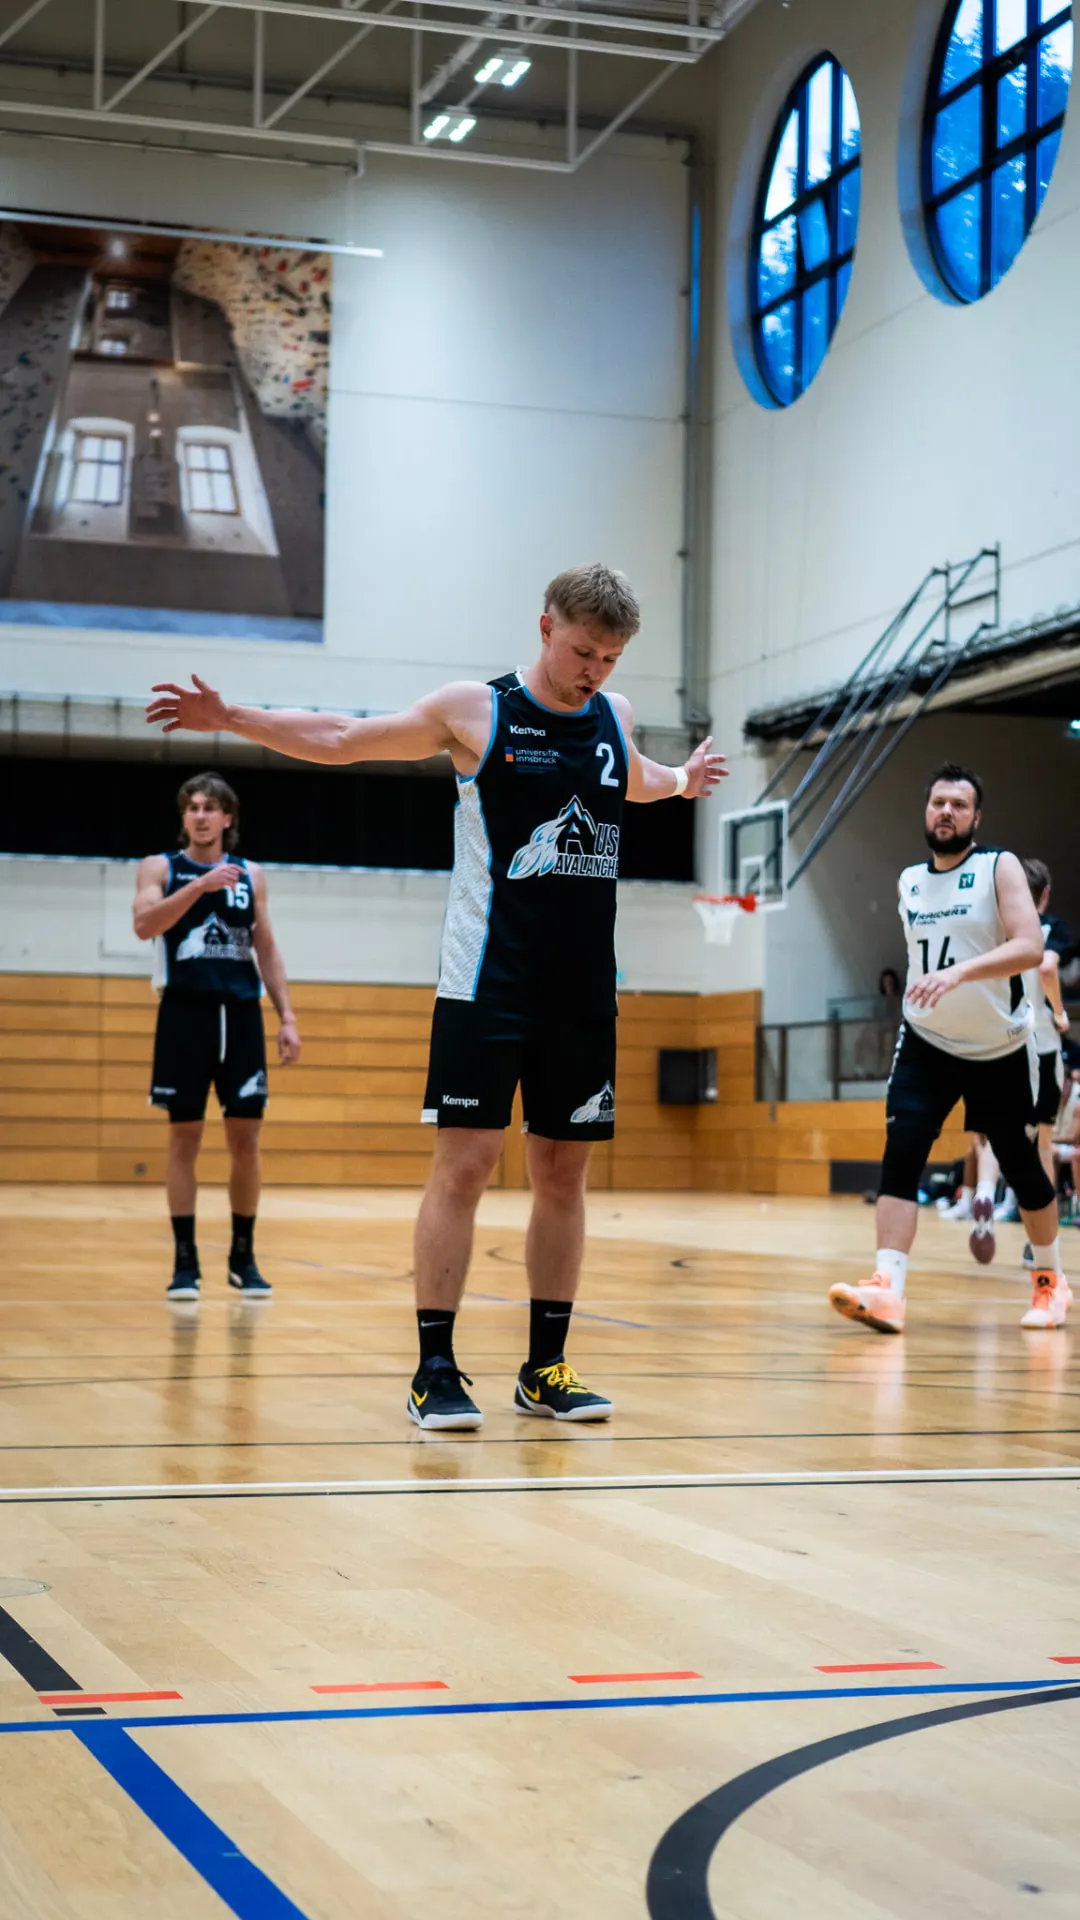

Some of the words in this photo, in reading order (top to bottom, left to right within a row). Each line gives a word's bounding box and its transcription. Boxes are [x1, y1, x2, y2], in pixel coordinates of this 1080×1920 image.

[509, 725, 546, 737] Kempa
[515, 755, 557, 764] innsbruck
[595, 742, 619, 787] 2
[224, 882, 249, 910] 15
[917, 936, 955, 975] 14
[442, 1095, 479, 1107] Kempa
